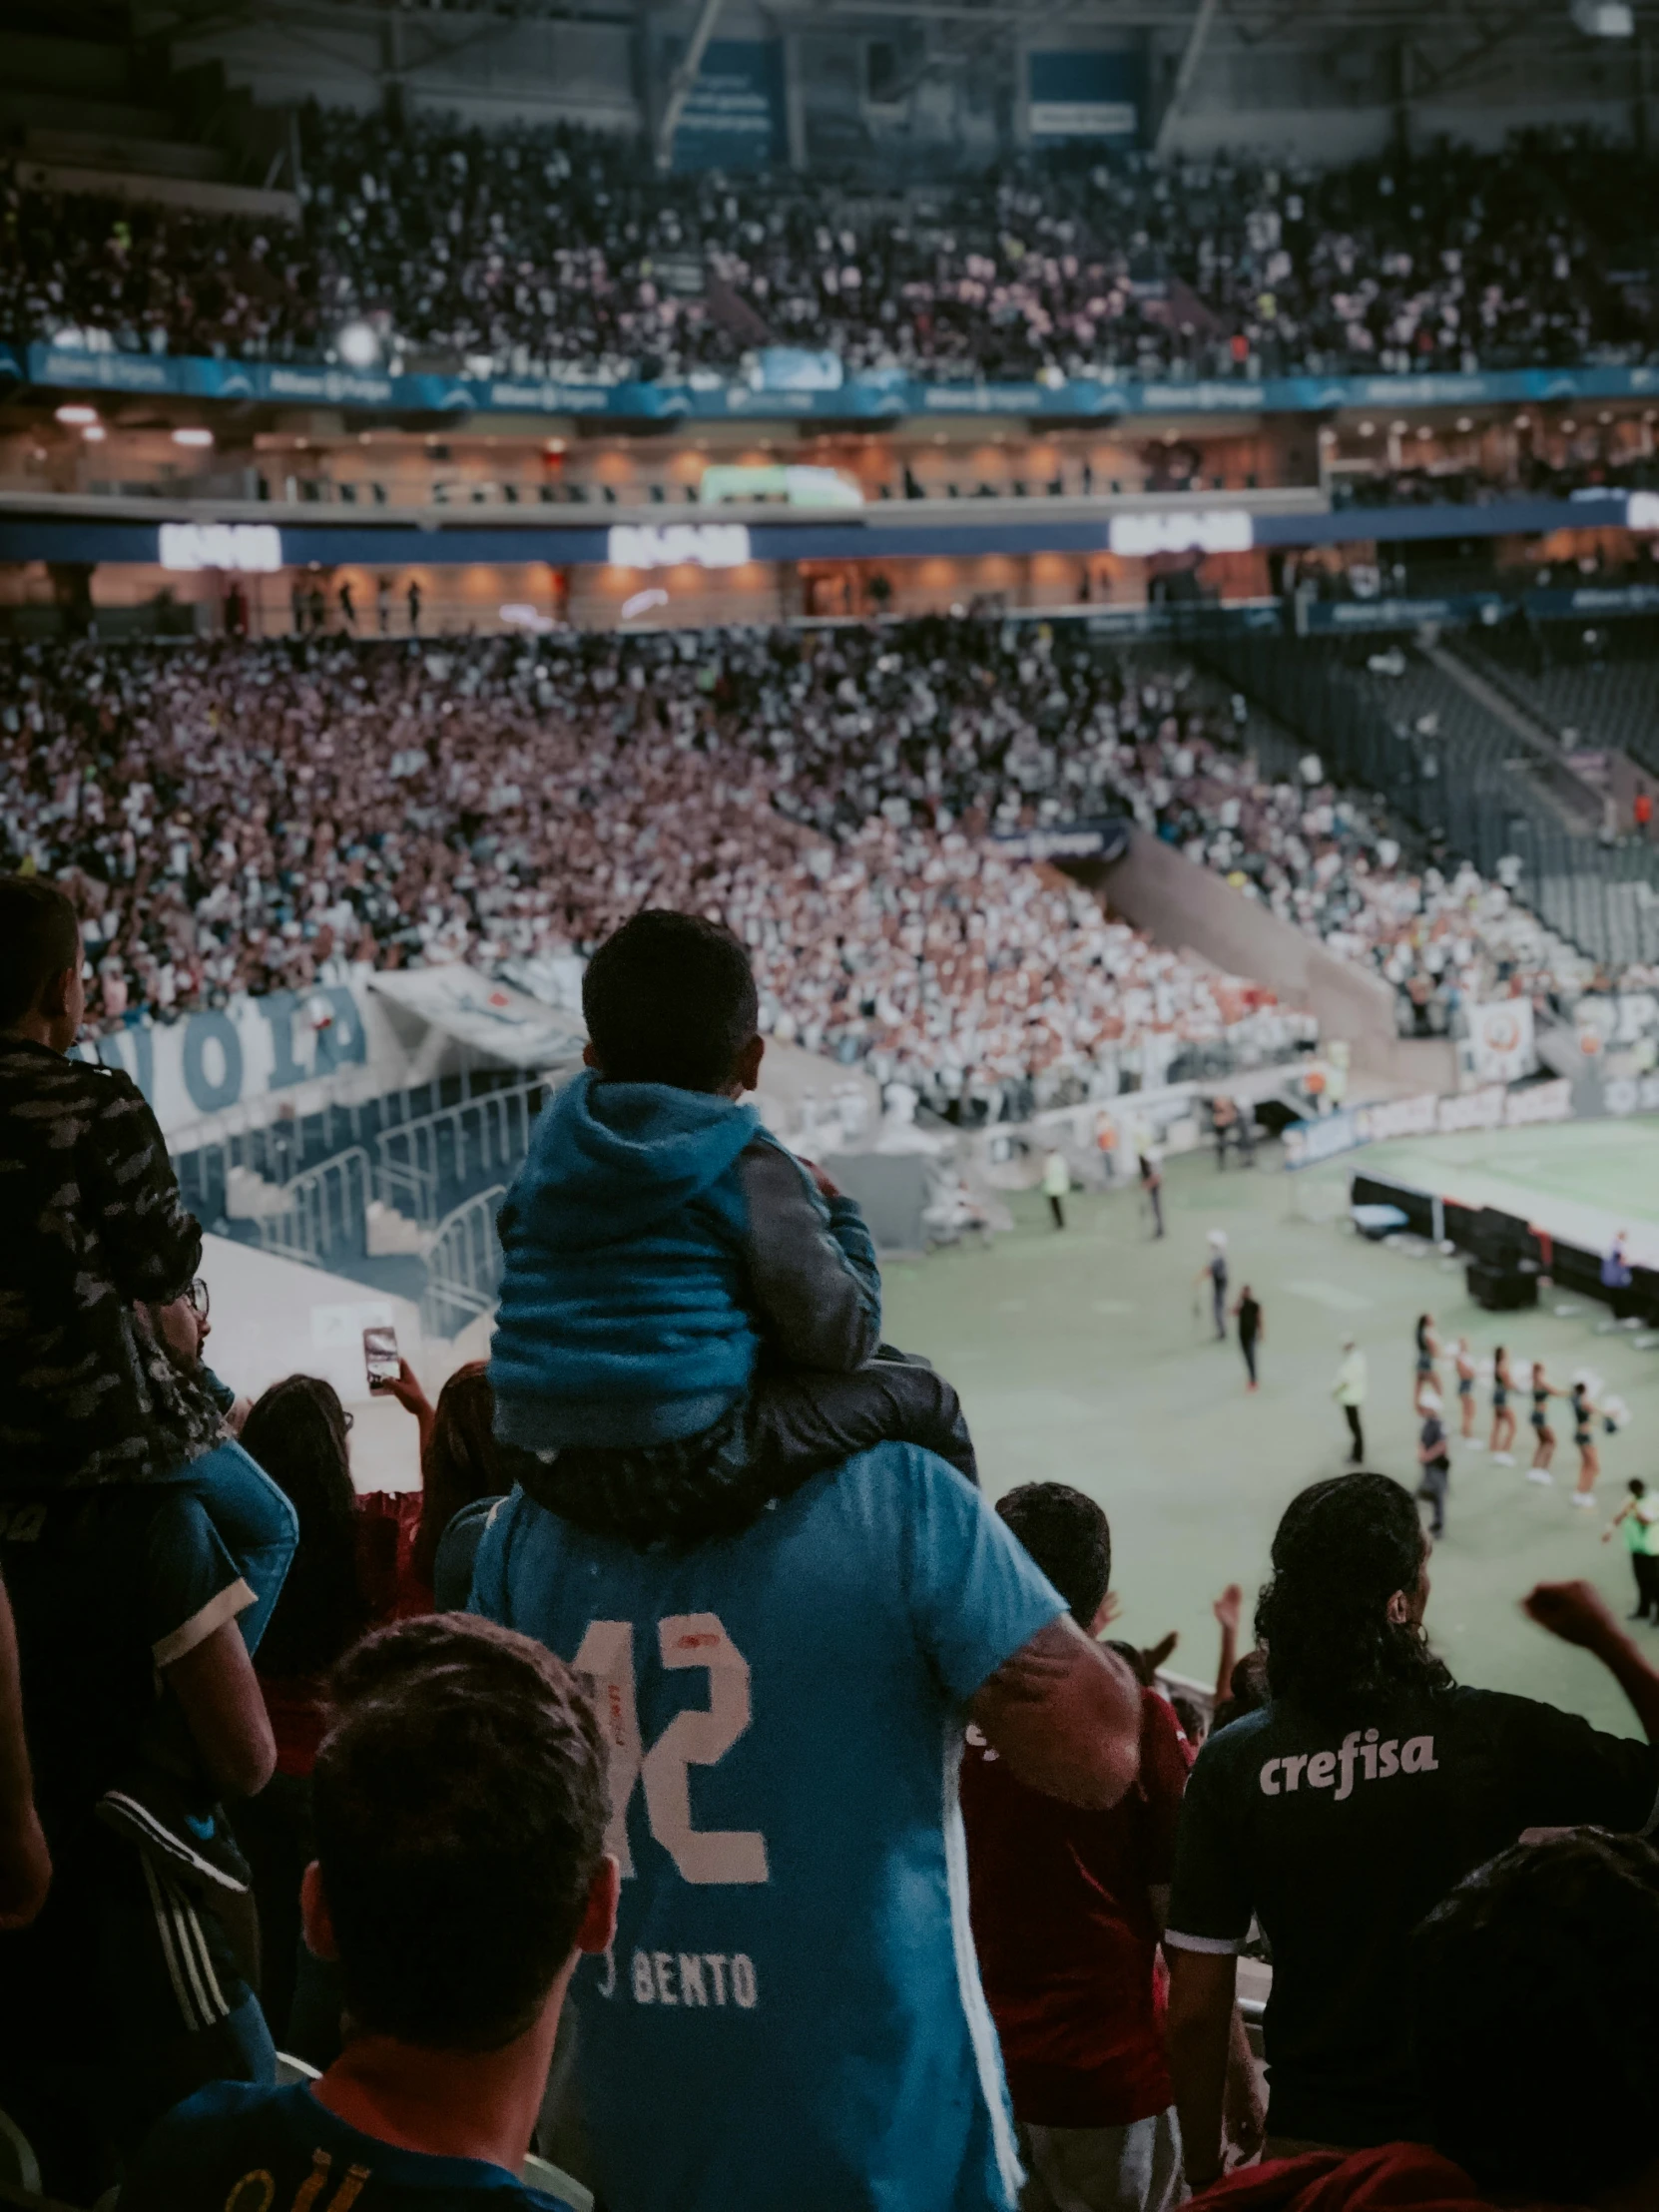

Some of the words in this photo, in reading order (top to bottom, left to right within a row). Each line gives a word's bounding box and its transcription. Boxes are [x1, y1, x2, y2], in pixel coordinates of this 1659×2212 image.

[572, 1612, 769, 1884] 12
[1260, 1728, 1438, 1801] crefisa
[632, 1947, 759, 2009] BENTO
